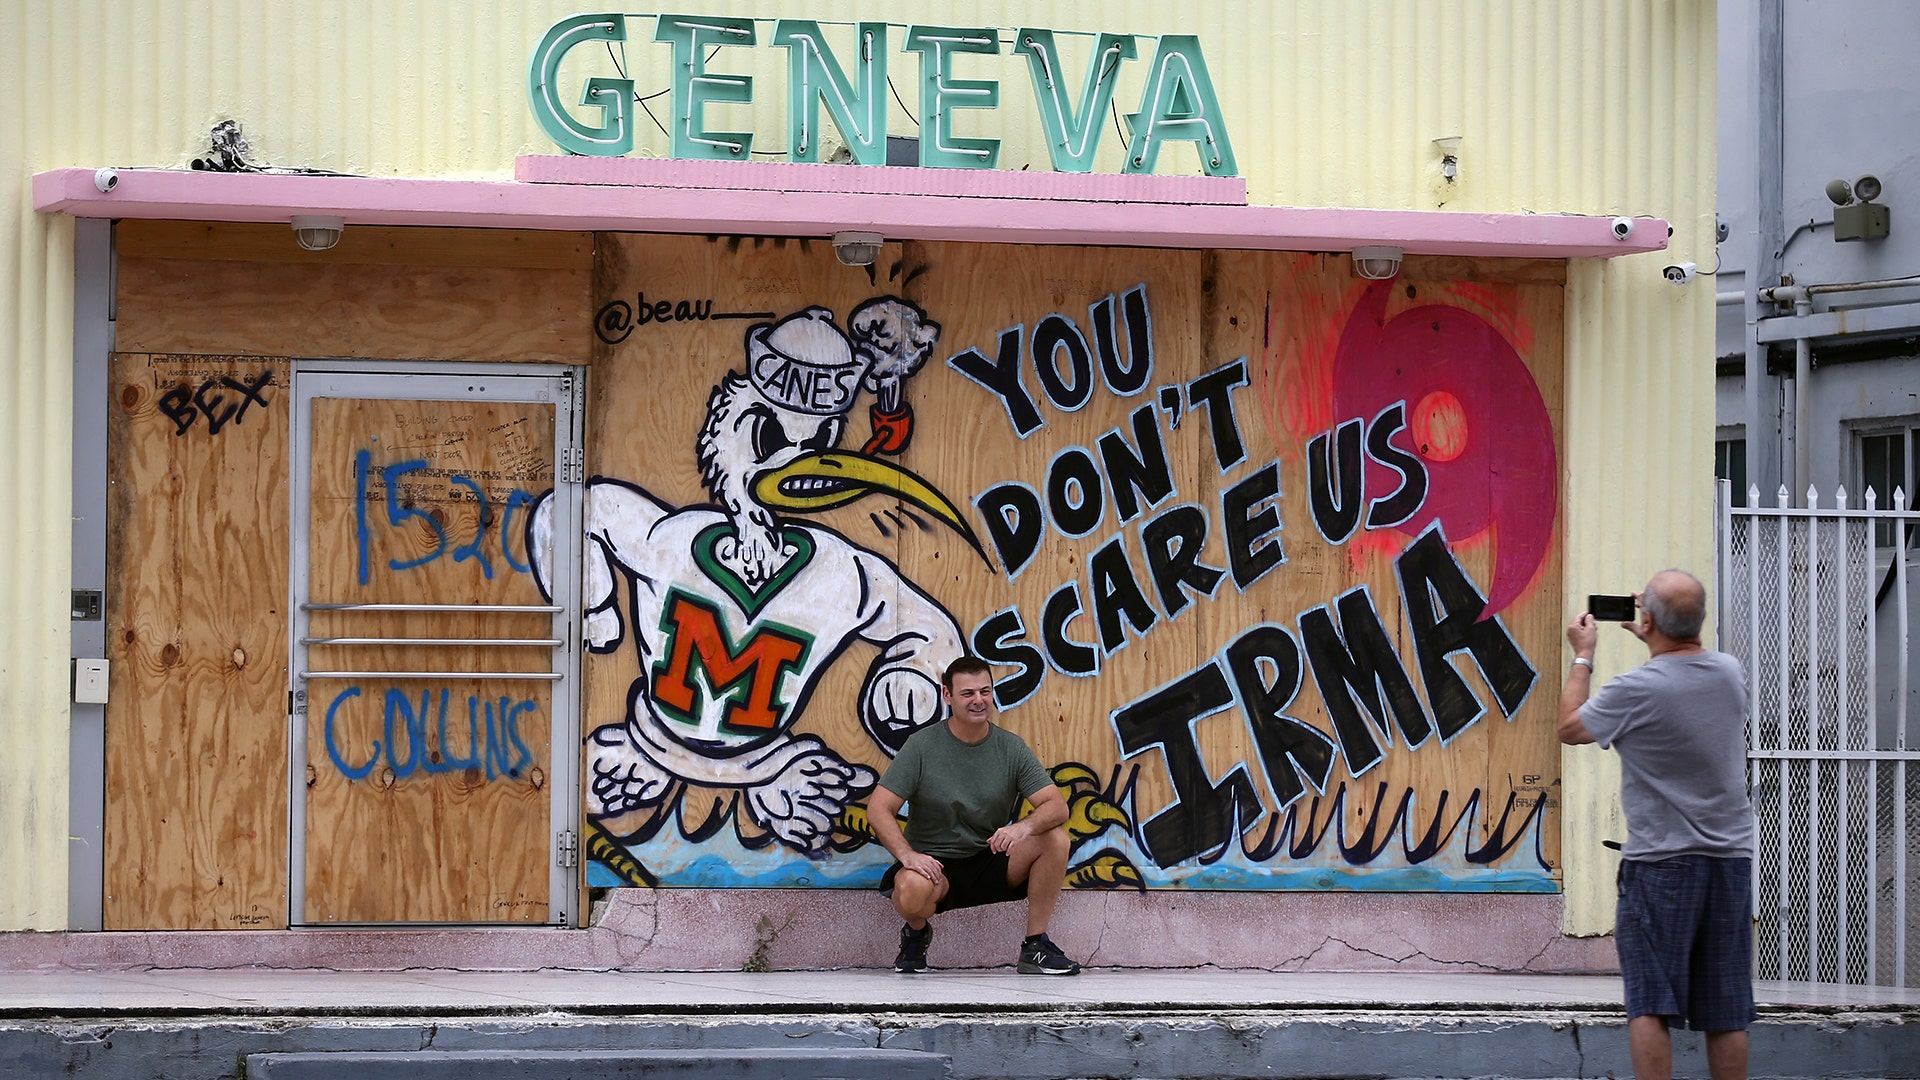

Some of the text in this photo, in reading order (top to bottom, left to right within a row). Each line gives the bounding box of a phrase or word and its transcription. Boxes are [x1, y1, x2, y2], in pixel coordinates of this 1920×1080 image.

[526, 13, 1241, 177] GENEVA
[158, 370, 272, 437] BEX
[755, 353, 856, 409] CANES
[947, 283, 1155, 439] YOU
[971, 357, 1250, 583] DON'T
[1306, 399, 1430, 546] US
[651, 584, 814, 737] M
[971, 459, 1288, 712] SCARE
[325, 687, 536, 782] COLLINS
[1110, 518, 1538, 869] IRMA
[1032, 951, 1047, 964] N
